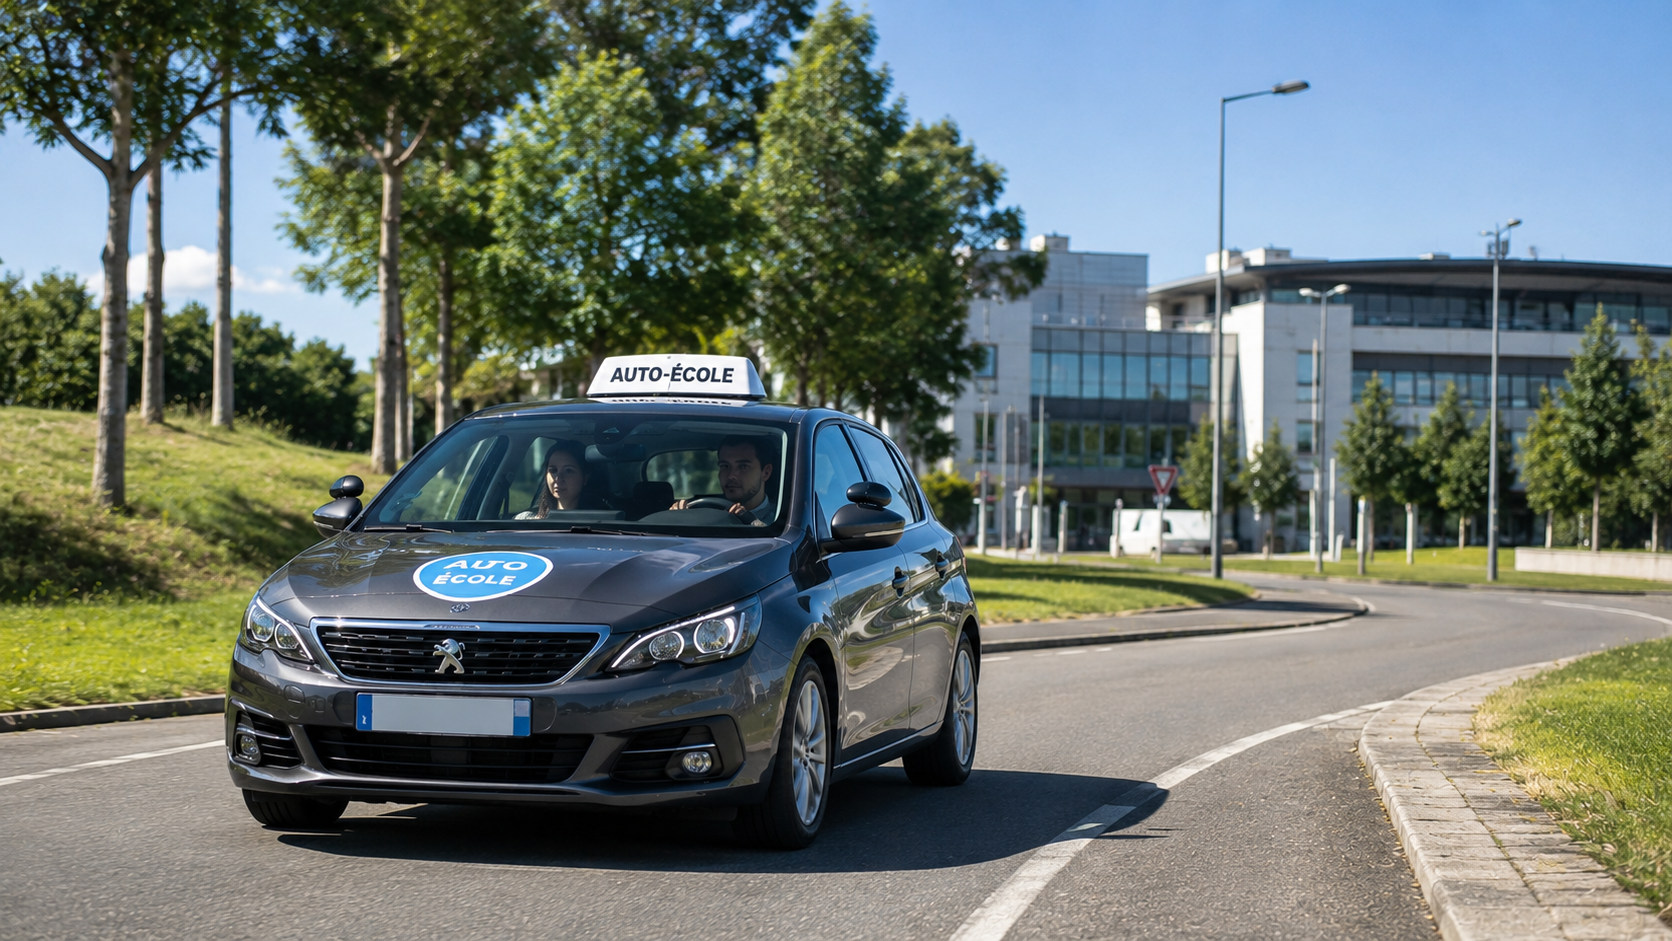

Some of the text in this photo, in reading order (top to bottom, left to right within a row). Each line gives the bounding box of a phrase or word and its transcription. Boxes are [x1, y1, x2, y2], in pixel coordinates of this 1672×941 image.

[610, 363, 734, 383] AUTO-ÉCOLE
[443, 559, 528, 571] AUTO
[432, 572, 517, 586] ÉCOLE
